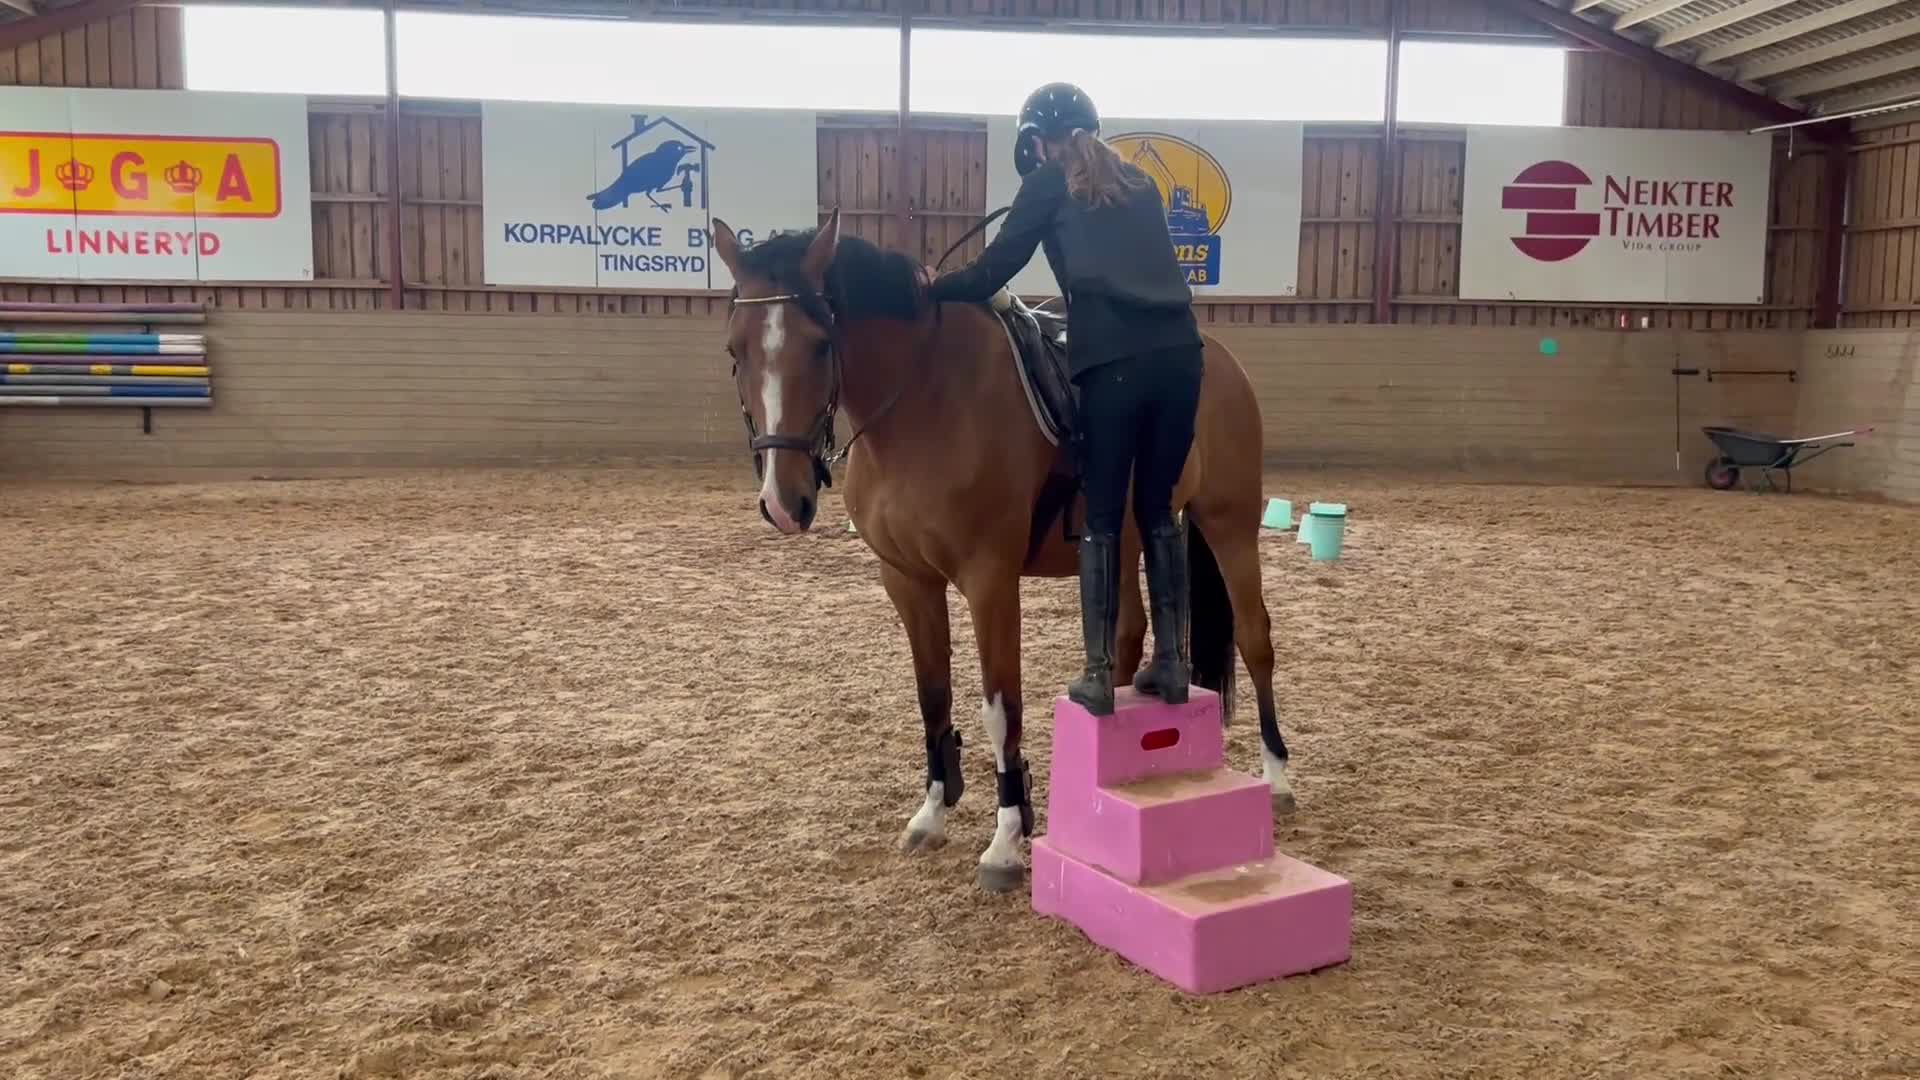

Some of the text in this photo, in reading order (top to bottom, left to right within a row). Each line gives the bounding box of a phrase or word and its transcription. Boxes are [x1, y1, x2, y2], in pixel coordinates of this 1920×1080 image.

[13, 148, 252, 202] J G A
[1604, 175, 1735, 208] NEIKTER
[504, 222, 662, 248] KORPALYCKE
[687, 228, 754, 250] BYG
[1604, 207, 1721, 239] TIMBER
[47, 229, 221, 256] LINNERYD
[600, 254, 705, 273] TINGSRYD
[1187, 269, 1208, 282] AB
